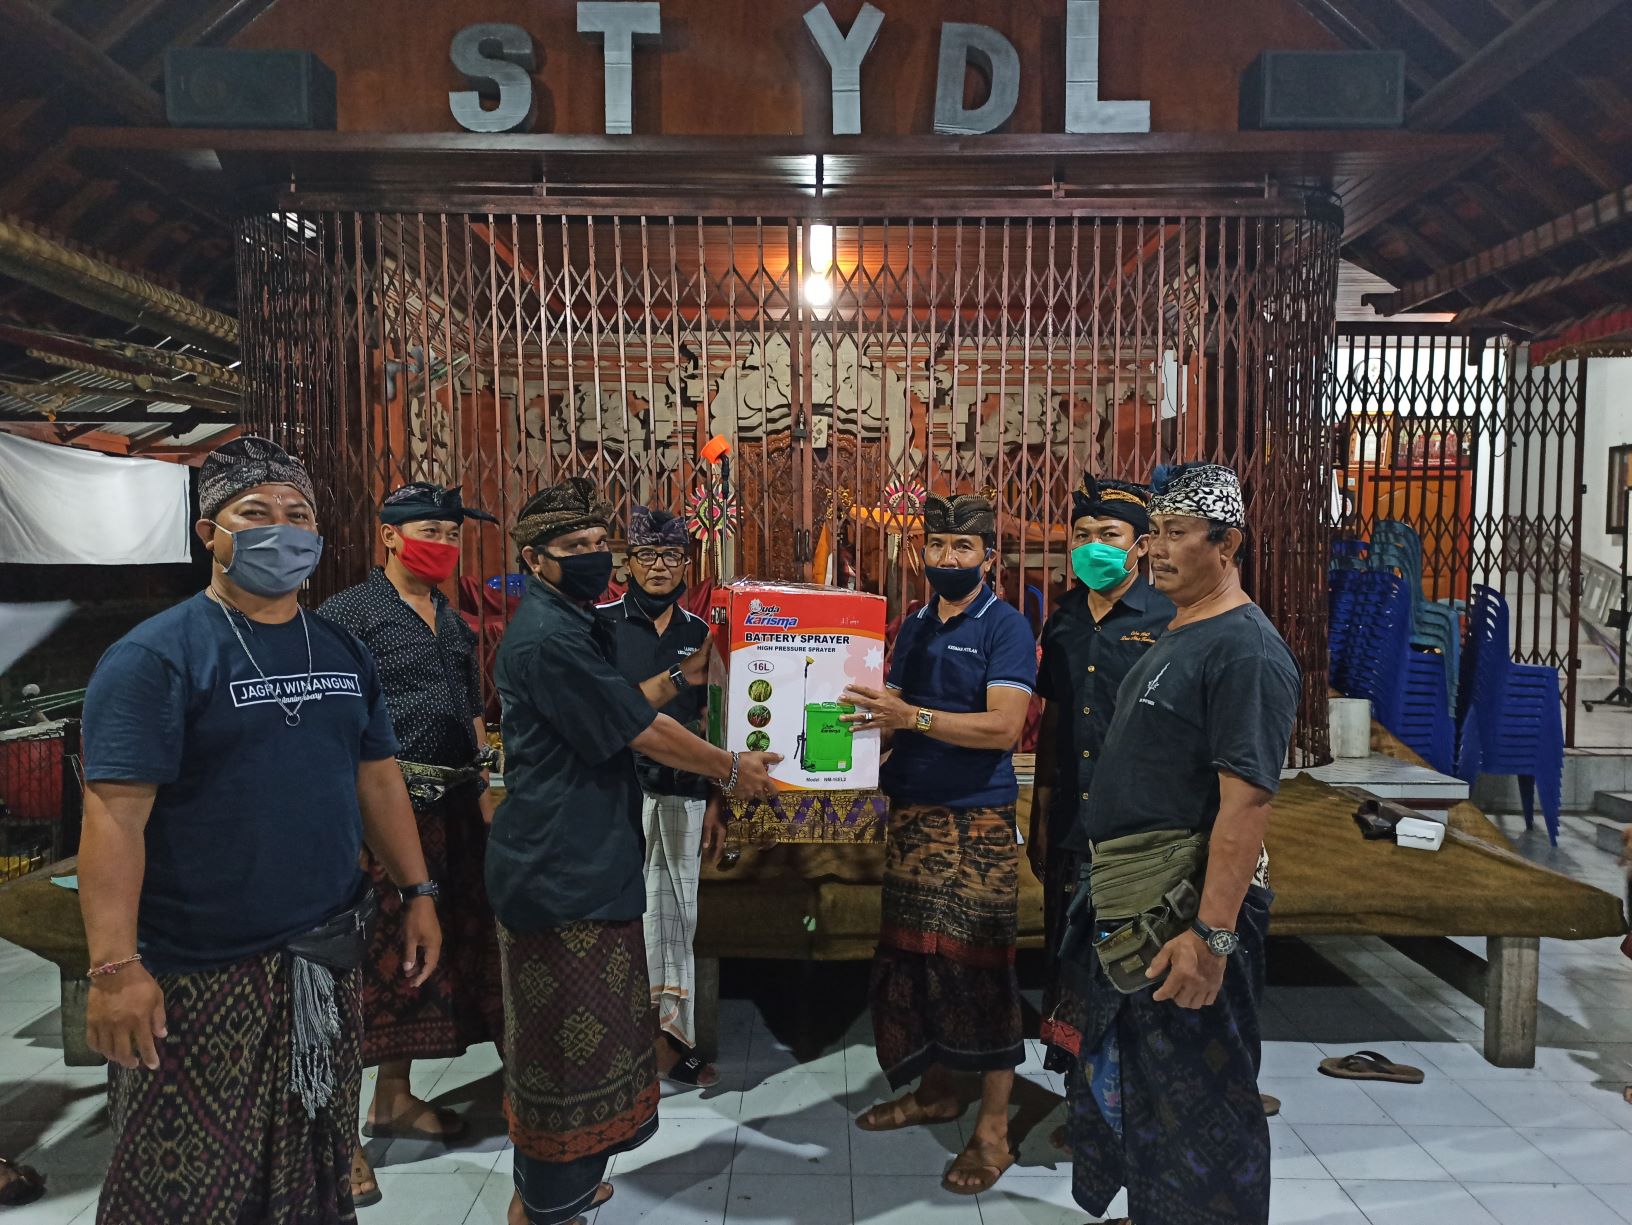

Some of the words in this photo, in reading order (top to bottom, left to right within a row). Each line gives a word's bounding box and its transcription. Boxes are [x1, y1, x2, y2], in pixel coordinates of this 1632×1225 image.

[745, 632, 797, 643] BATTERY
[799, 635, 850, 644] SPRAYER
[753, 662, 770, 672] 16L
[283, 677, 356, 695] WINANGUN
